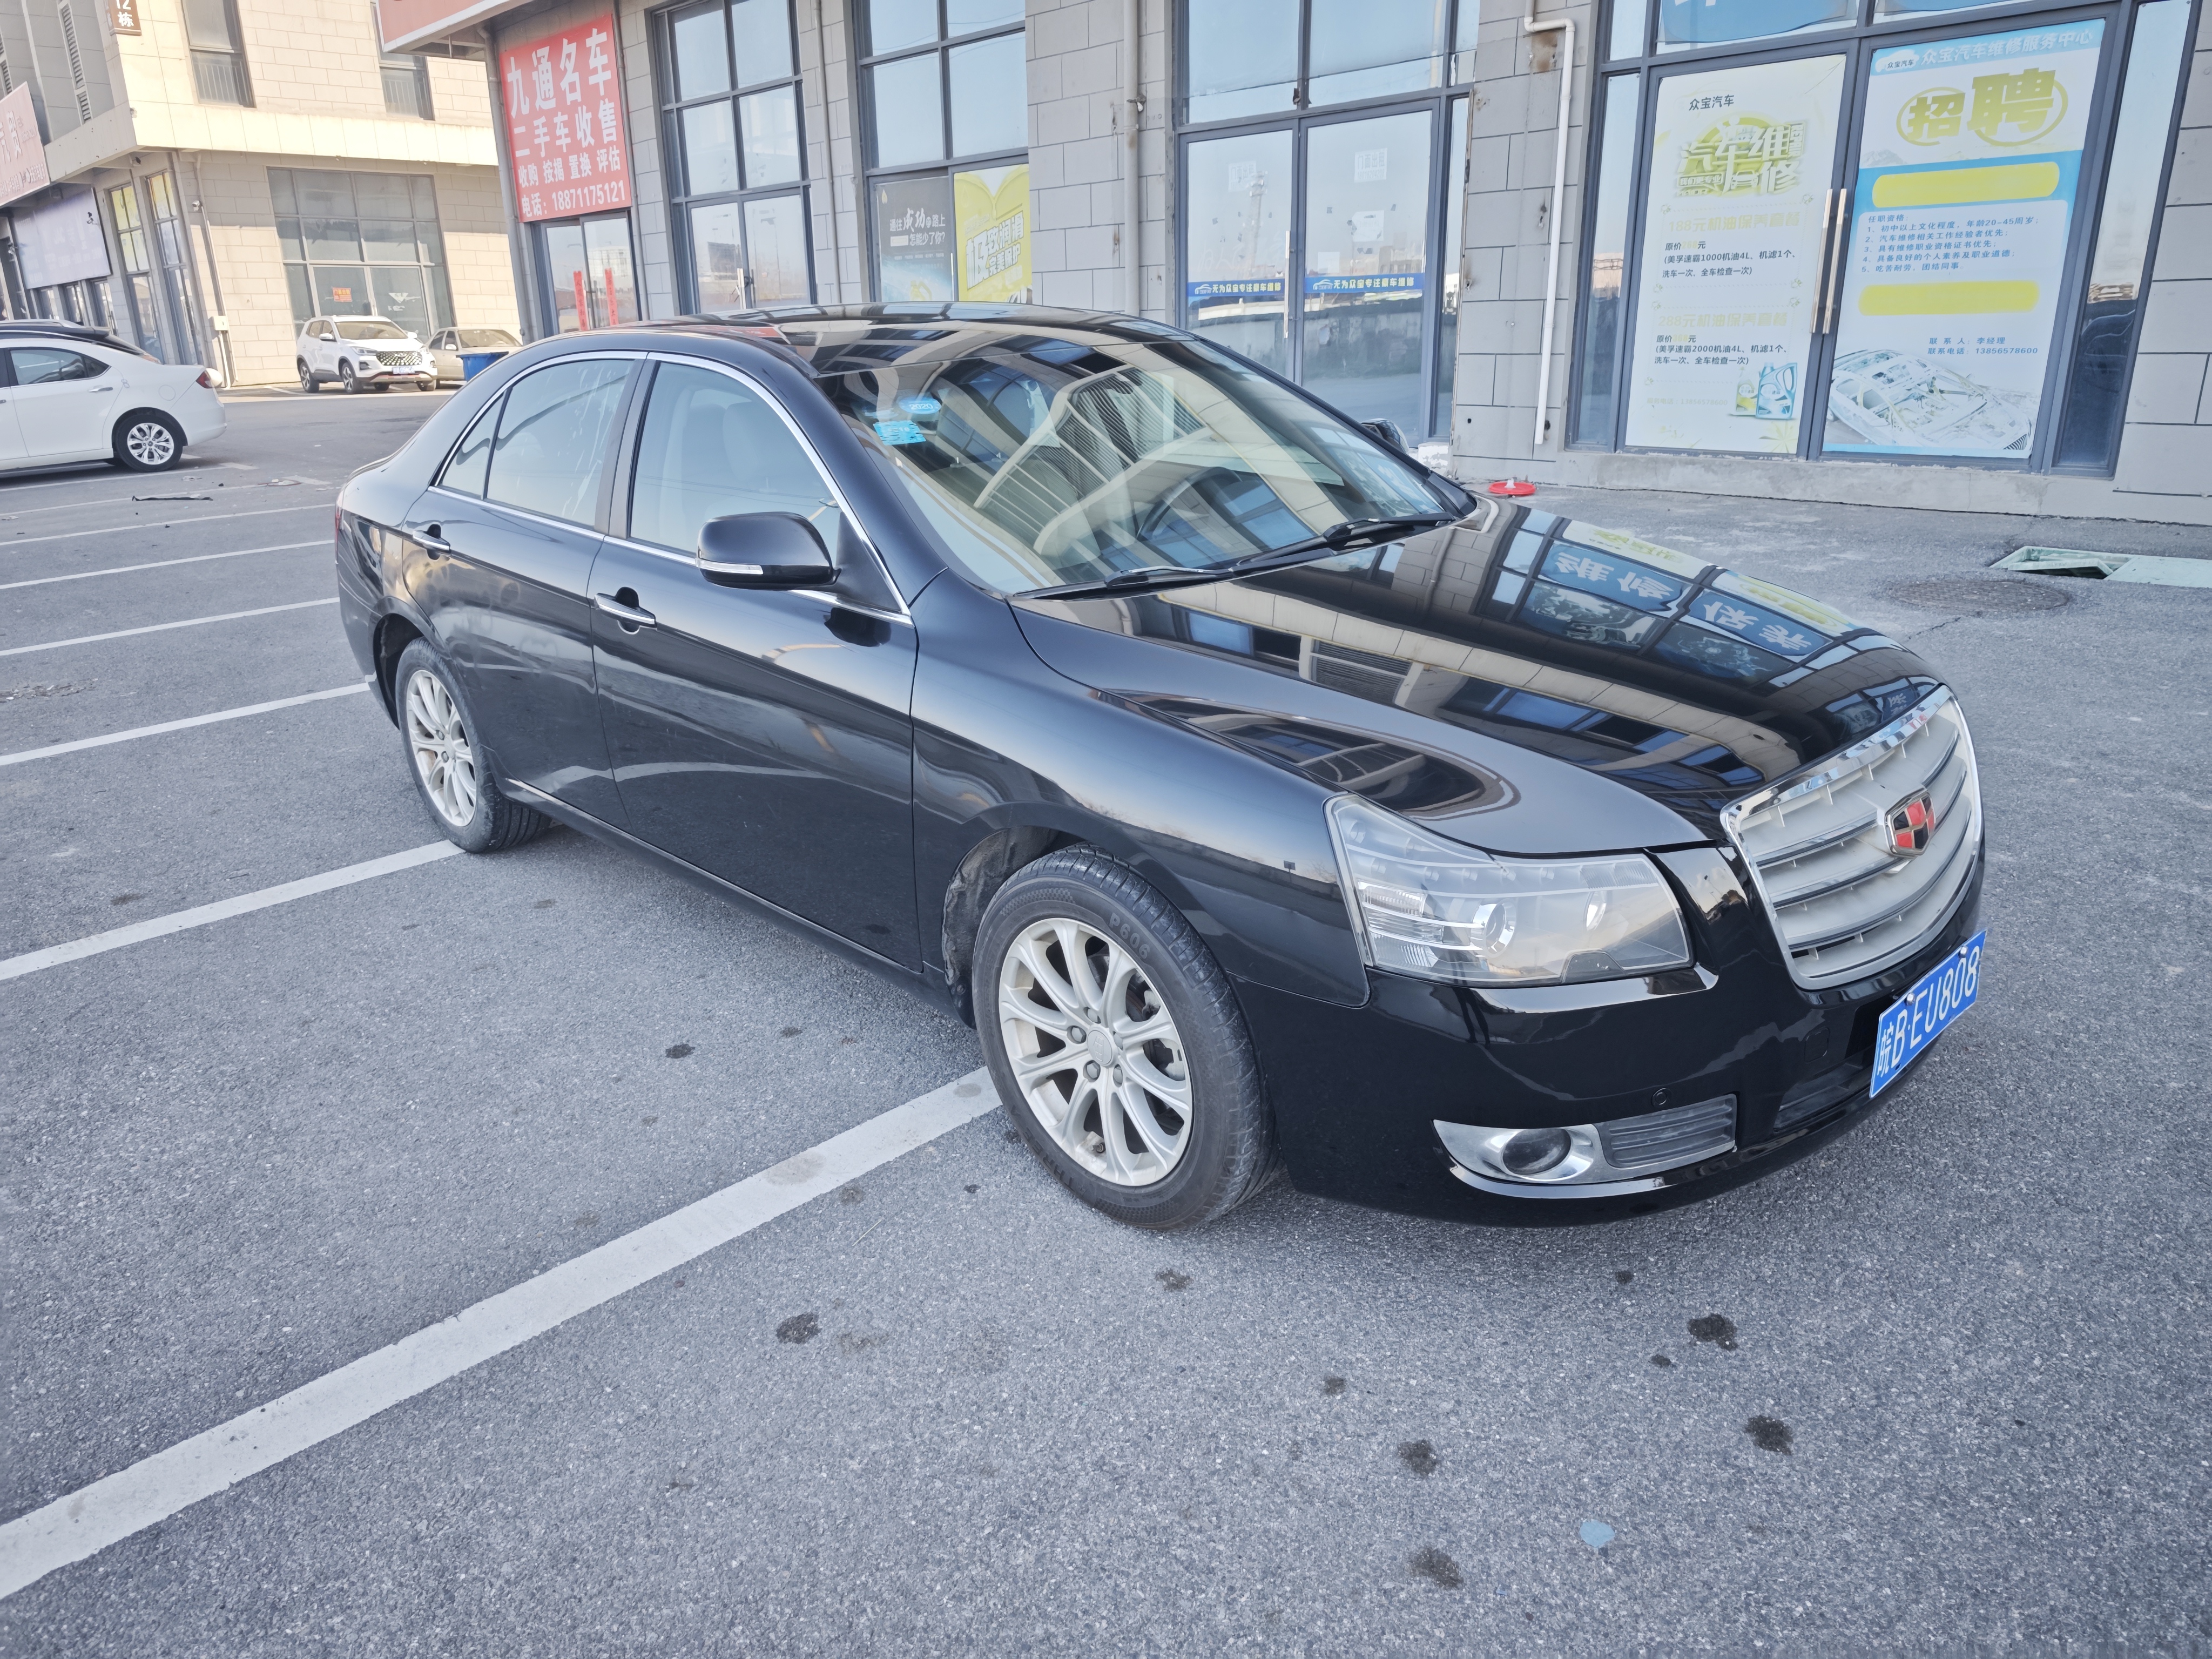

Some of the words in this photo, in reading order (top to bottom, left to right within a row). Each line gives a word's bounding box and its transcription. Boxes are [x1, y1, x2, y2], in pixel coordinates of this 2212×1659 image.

[117, 11, 134, 26] 栋
[1887, 58, 1914, 69] 众宝汽车
[1921, 29, 2093, 65] 众宝汽车维修服务中心
[507, 28, 612, 118] 九通名车
[1689, 95, 1734, 111] 众宝汽车
[1906, 67, 2056, 140] 招聘
[514, 98, 617, 157] 二手车收售
[518, 163, 538, 188] 收购
[543, 158, 564, 184] 按揭
[569, 152, 591, 179] 置换
[597, 146, 621, 173] 评估
[1669, 211, 1800, 232] 188元机油保养套餐
[966, 210, 1024, 291] 极致润滑
[989, 242, 1021, 278] 完美保护
[1212, 282, 1281, 293] 无为众宝专注豪车维修
[1333, 277, 1414, 289] 无为众宝专注豪车维修
[1658, 312, 1788, 328] 288元机油保养套餐
[1109, 912, 1150, 959] P606
